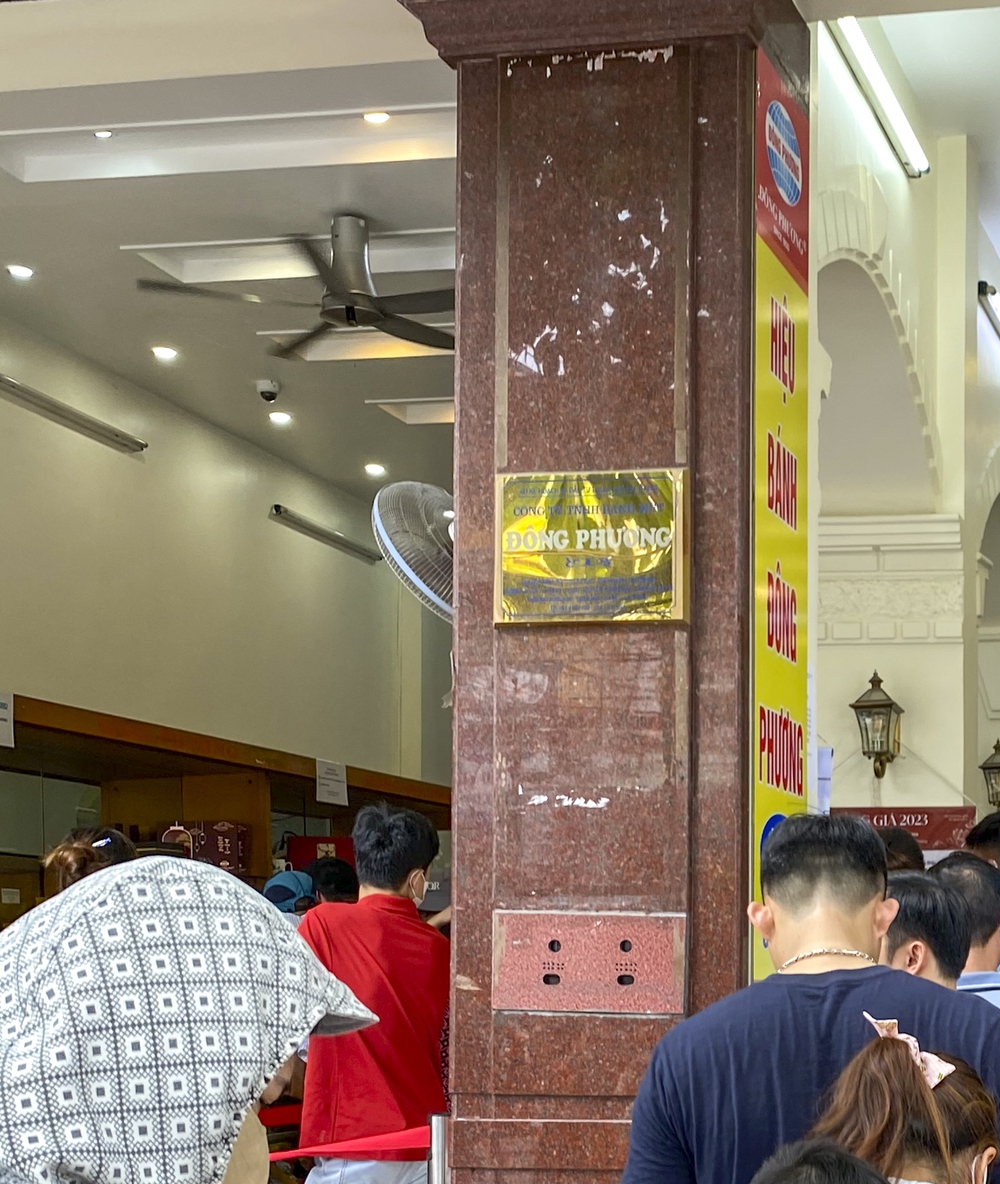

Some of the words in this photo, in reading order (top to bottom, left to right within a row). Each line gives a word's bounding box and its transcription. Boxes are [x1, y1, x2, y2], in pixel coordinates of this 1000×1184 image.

[770, 292, 796, 405] HIỆU
[767, 422, 798, 533] BÁNH
[506, 524, 570, 552] ĐÔNG
[575, 526, 672, 551] PHƯƠNG
[759, 703, 804, 799] PHƯƠNG
[899, 814, 929, 827] 2023
